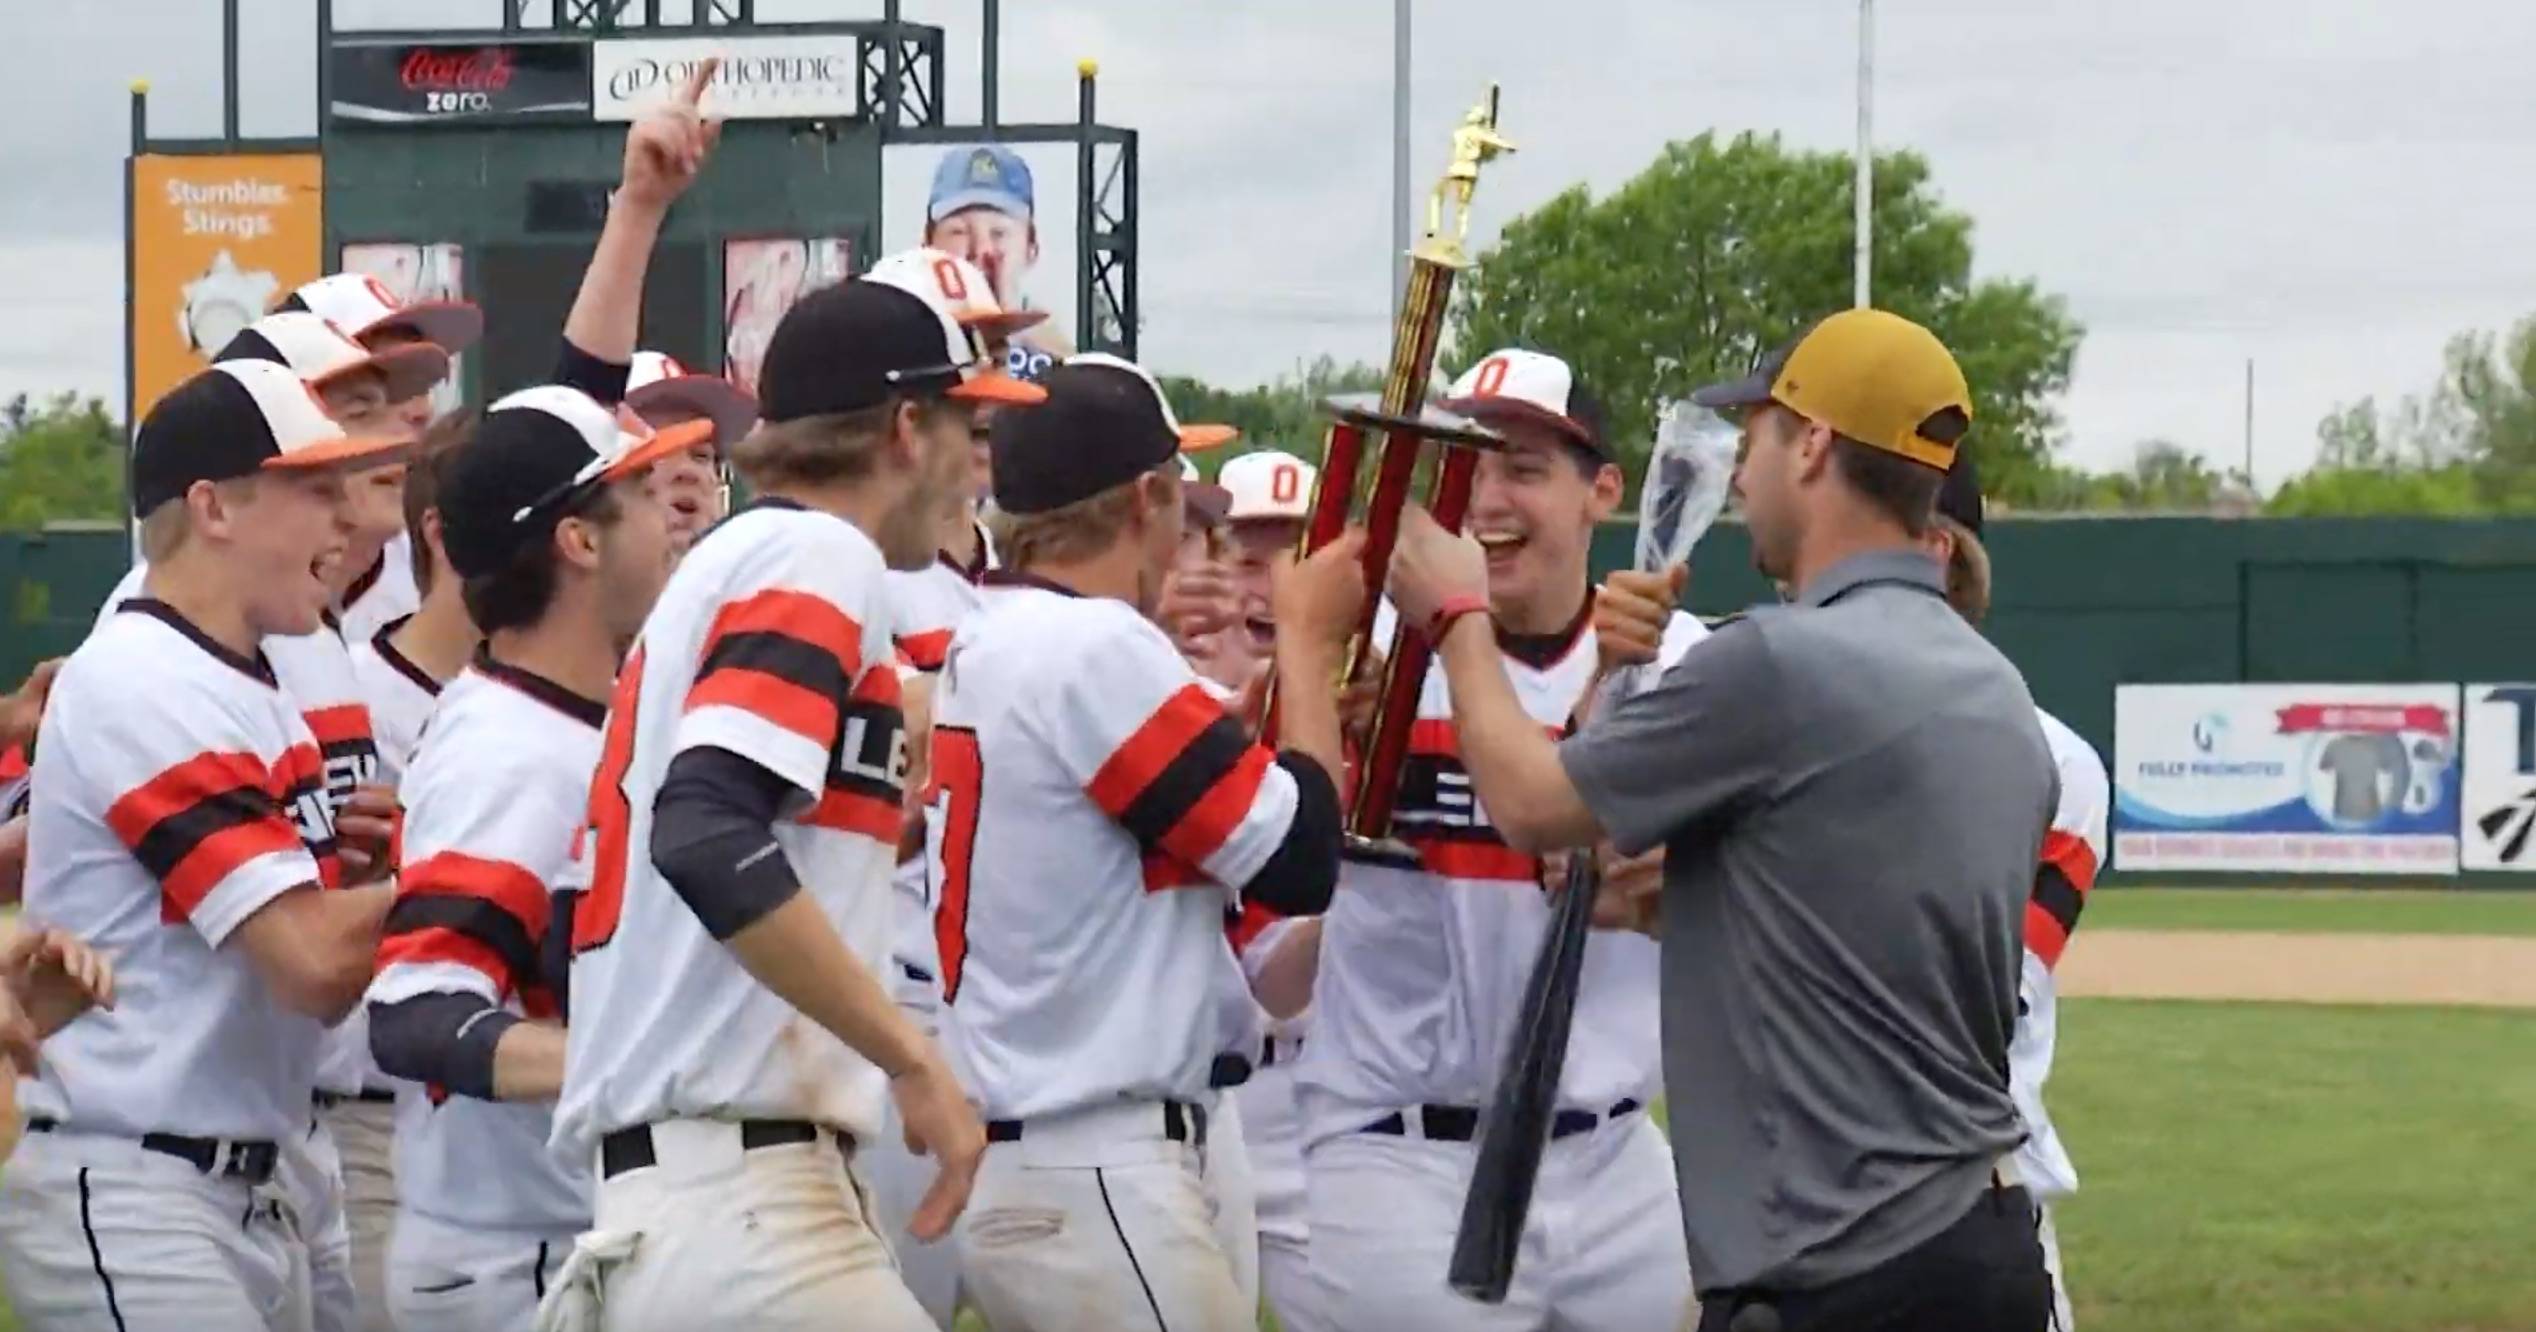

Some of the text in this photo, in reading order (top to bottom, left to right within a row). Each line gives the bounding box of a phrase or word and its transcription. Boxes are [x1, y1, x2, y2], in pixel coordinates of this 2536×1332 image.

[664, 54, 844, 86] OHOPEDIC
[1473, 357, 1509, 398] O
[1272, 463, 1298, 503] O
